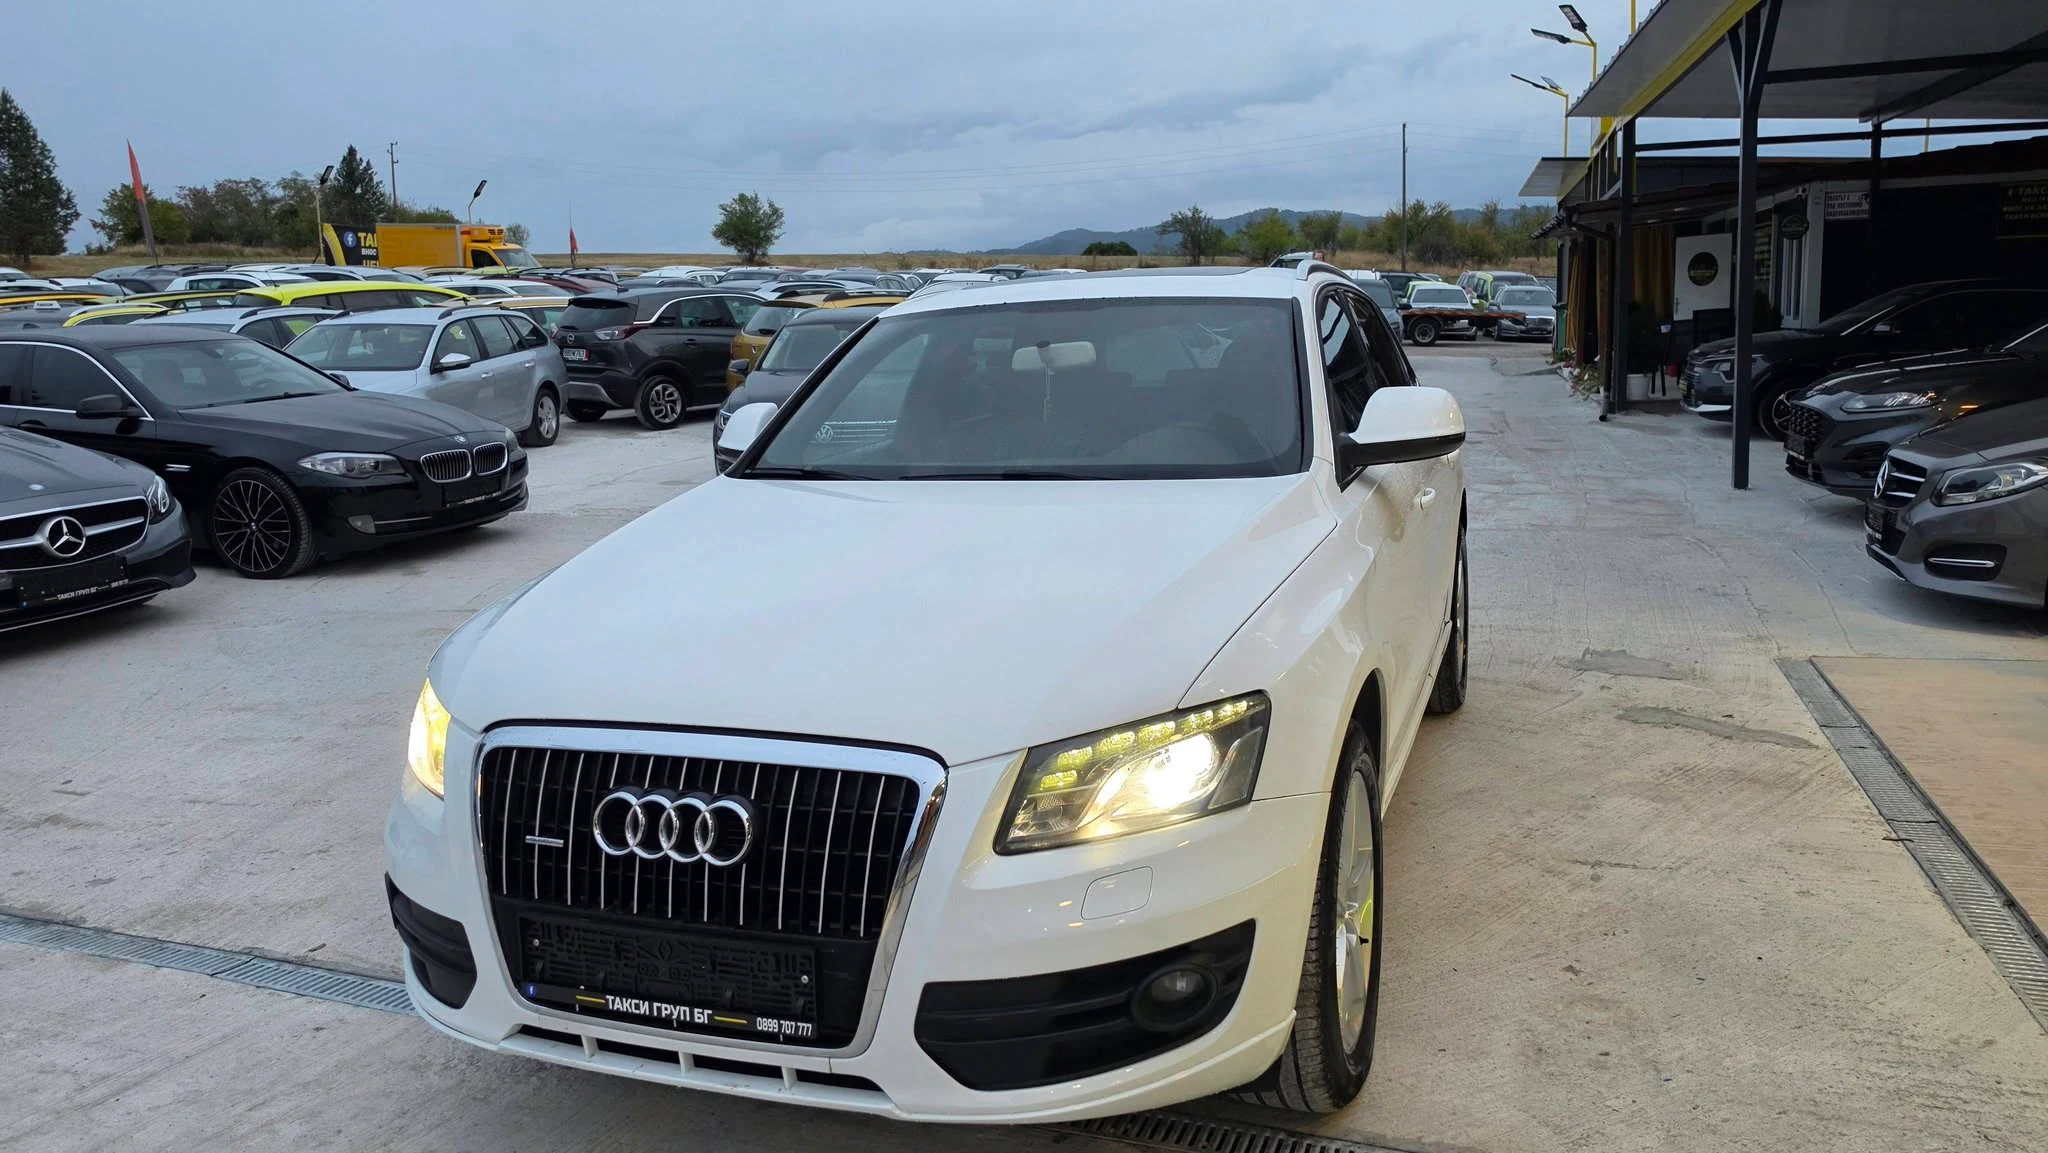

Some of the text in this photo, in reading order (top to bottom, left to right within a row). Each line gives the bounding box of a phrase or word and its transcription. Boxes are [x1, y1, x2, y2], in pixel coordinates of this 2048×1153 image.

[605, 995, 713, 1024] ТАКСИ ГРУП БГ
[756, 1016, 812, 1037] 0899 707 777
